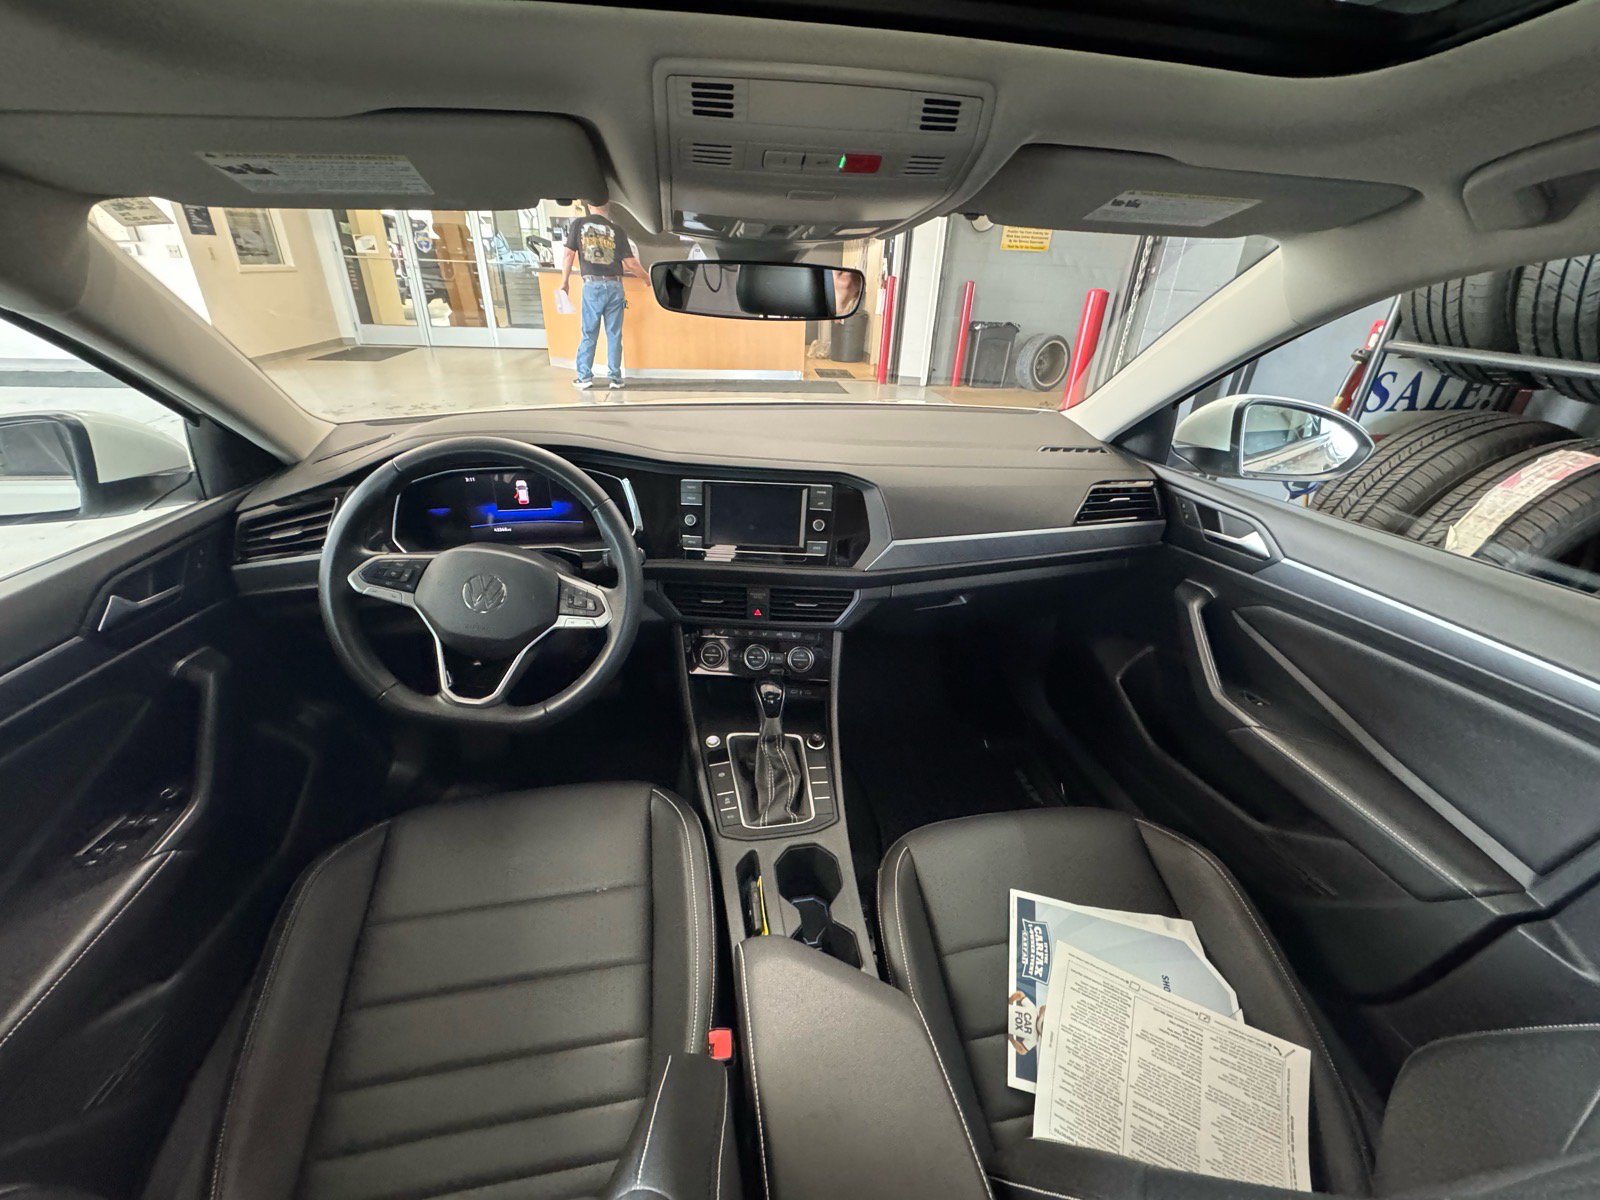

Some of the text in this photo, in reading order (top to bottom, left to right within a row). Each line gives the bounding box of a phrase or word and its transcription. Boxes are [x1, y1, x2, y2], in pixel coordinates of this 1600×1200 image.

[1034, 926, 1045, 978] CARFAX
[1028, 954, 1036, 976] EVENT
[1014, 1011, 1024, 1032] FOX
[1023, 1012, 1033, 1035] CAR
